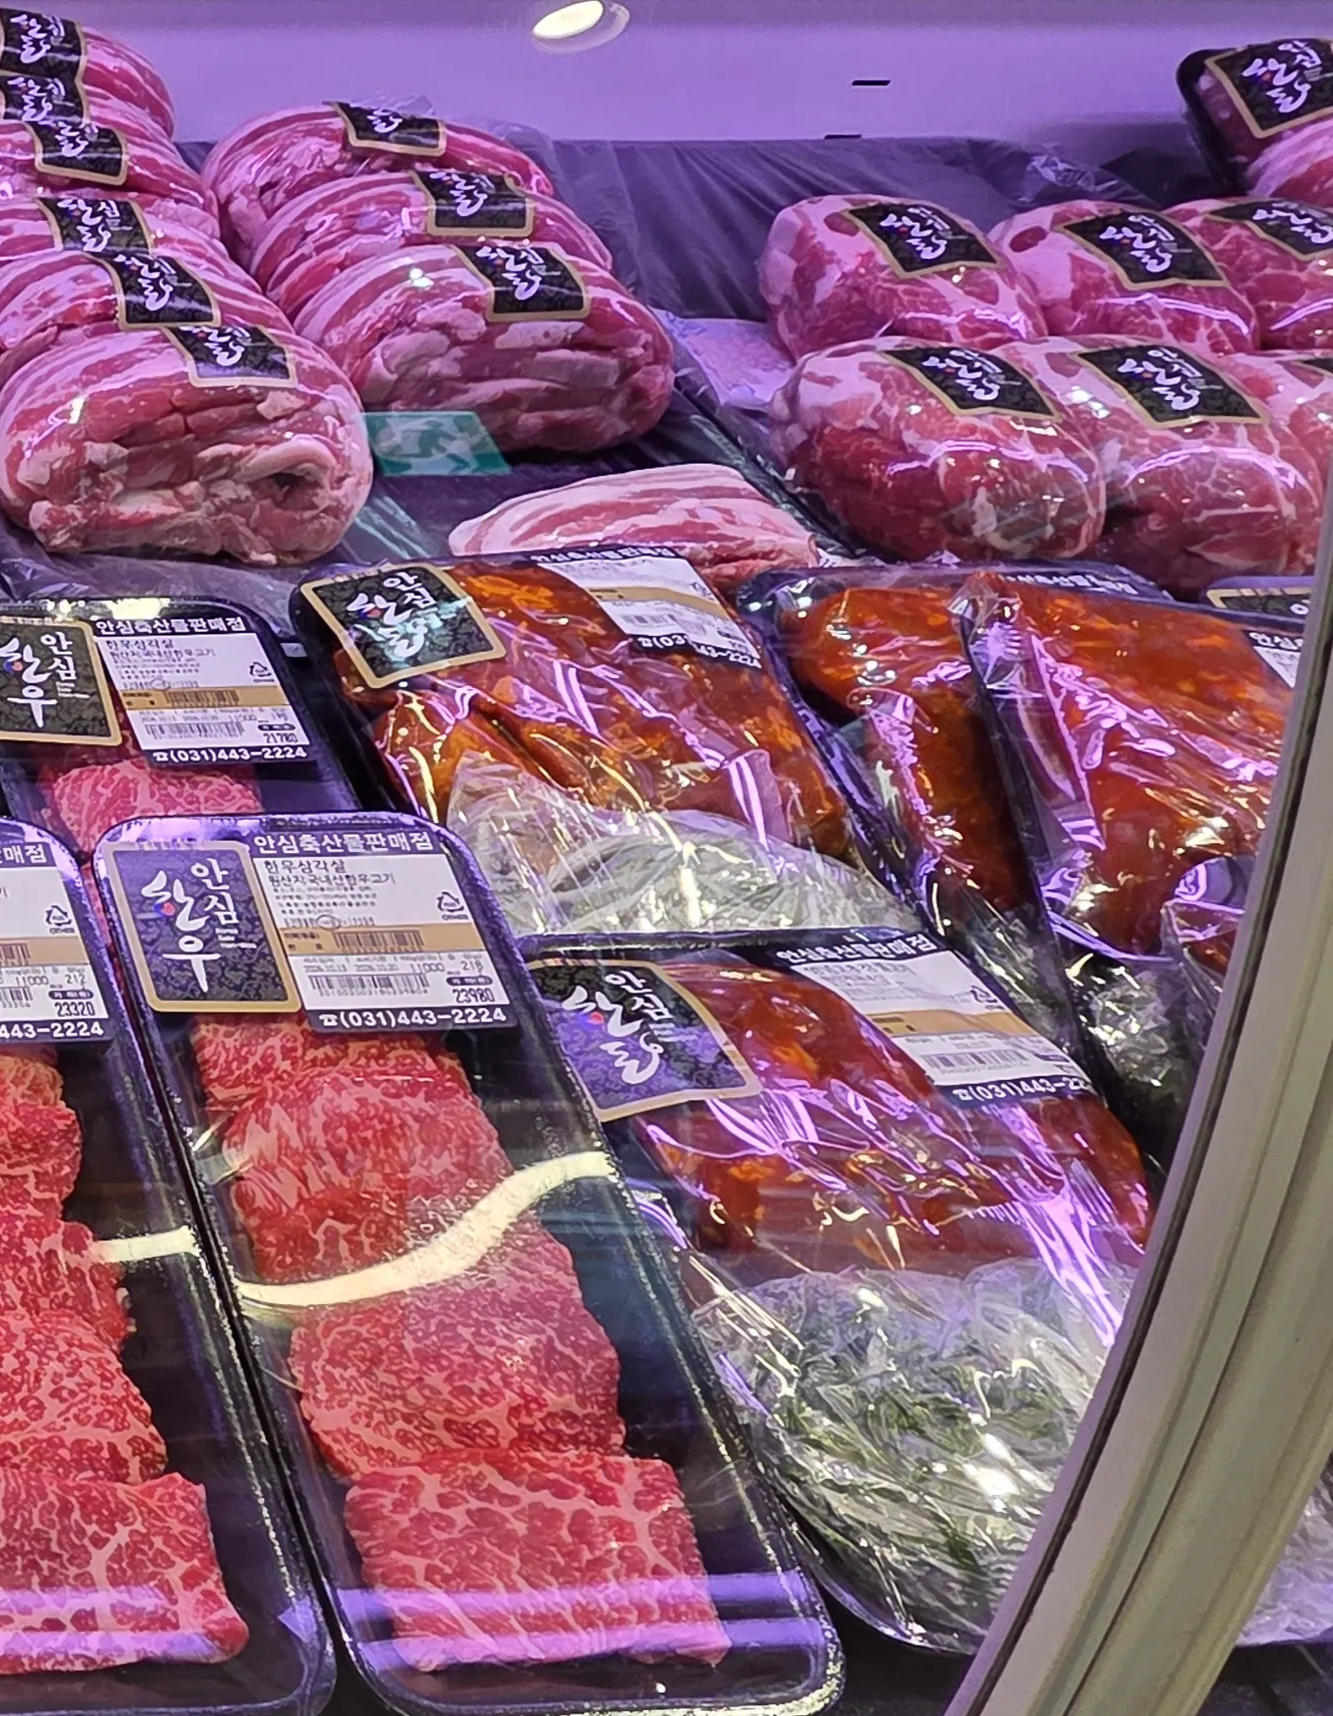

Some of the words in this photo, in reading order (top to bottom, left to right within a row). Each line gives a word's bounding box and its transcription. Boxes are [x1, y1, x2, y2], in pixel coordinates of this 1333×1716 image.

[170, 746, 309, 763] (031)443-2224
[253, 831, 434, 854] 안심축산물판매점
[142, 870, 220, 993] 한우
[452, 988, 495, 1003] 23980
[54, 1001, 95, 1017] 23320
[340, 1009, 507, 1028] (031)443-2224
[971, 1074, 1087, 1101] (031)443-22
